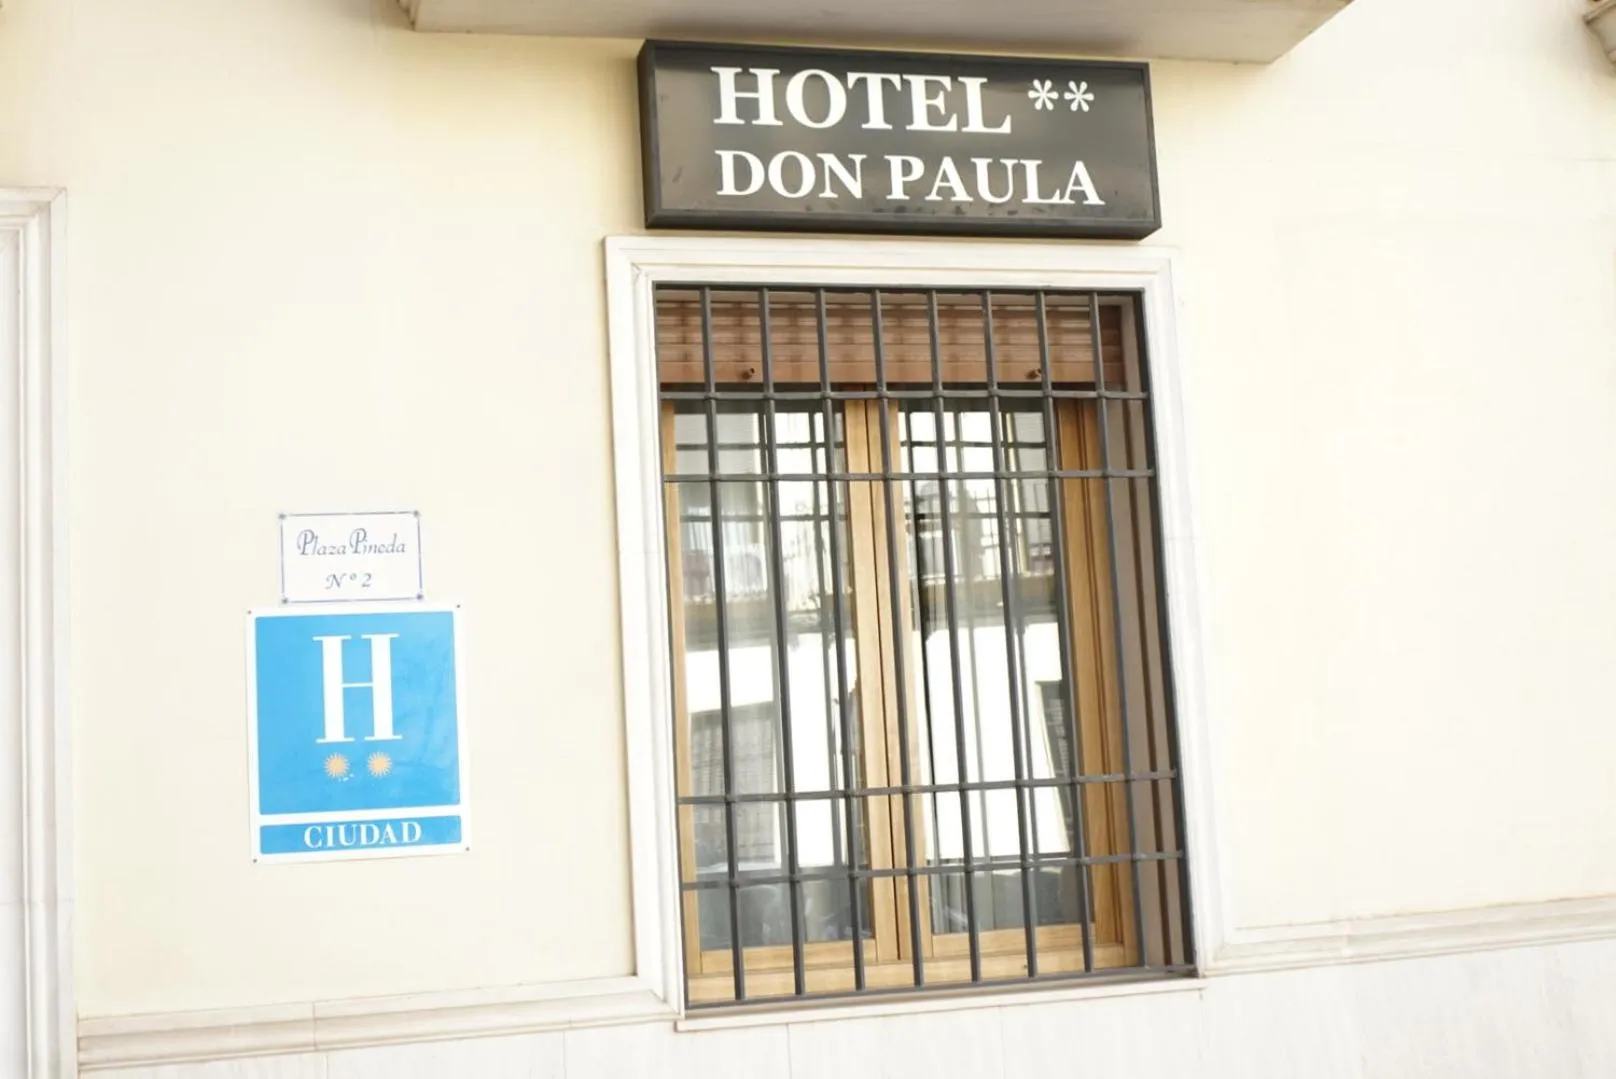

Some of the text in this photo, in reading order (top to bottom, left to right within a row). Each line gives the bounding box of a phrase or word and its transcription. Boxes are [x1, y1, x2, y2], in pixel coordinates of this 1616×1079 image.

[710, 65, 1012, 134] HOTEL
[715, 149, 1105, 206] DON PAULA
[297, 527, 406, 556] Plaza Pineda
[361, 572, 372, 588] 2
[312, 632, 403, 744] H
[303, 821, 422, 849] CIUDAD
